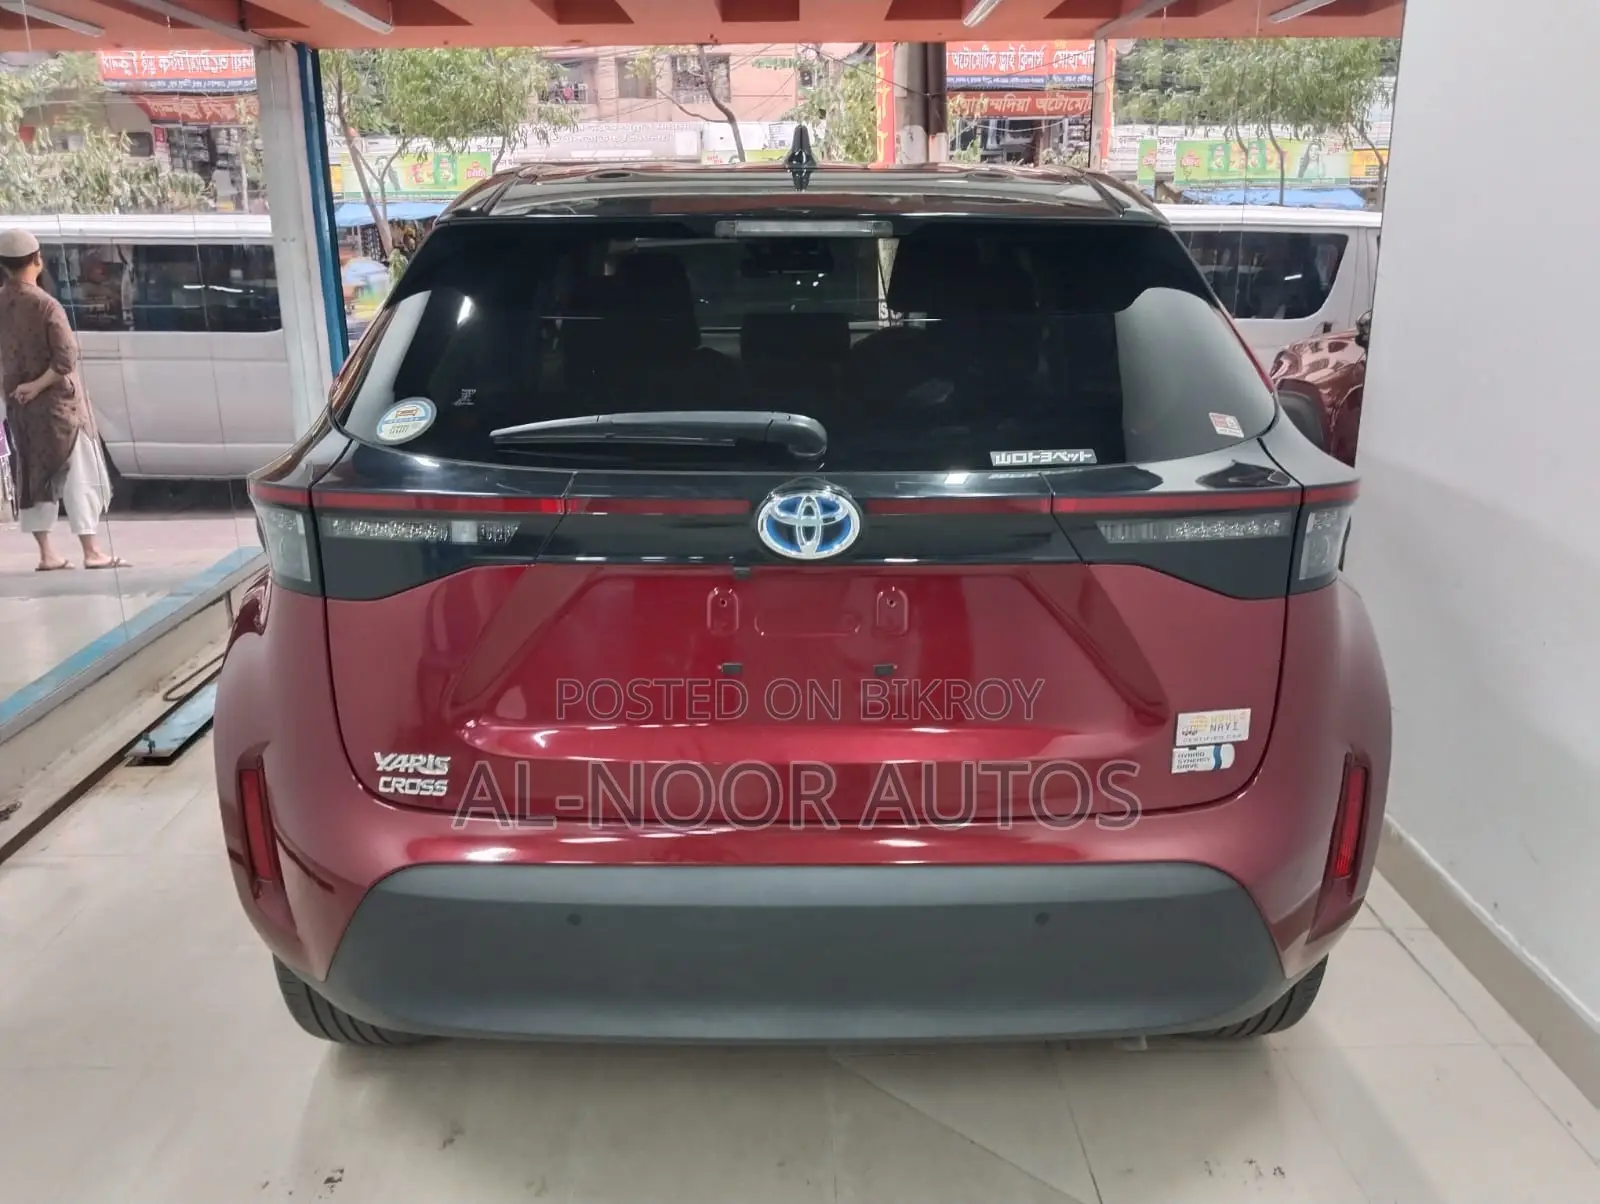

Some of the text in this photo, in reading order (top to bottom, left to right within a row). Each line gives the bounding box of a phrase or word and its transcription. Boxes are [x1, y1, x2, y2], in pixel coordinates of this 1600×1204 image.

[995, 450, 1093, 465] 山口トヨペット
[374, 752, 452, 776] YARIS
[378, 776, 449, 797] CROSS
